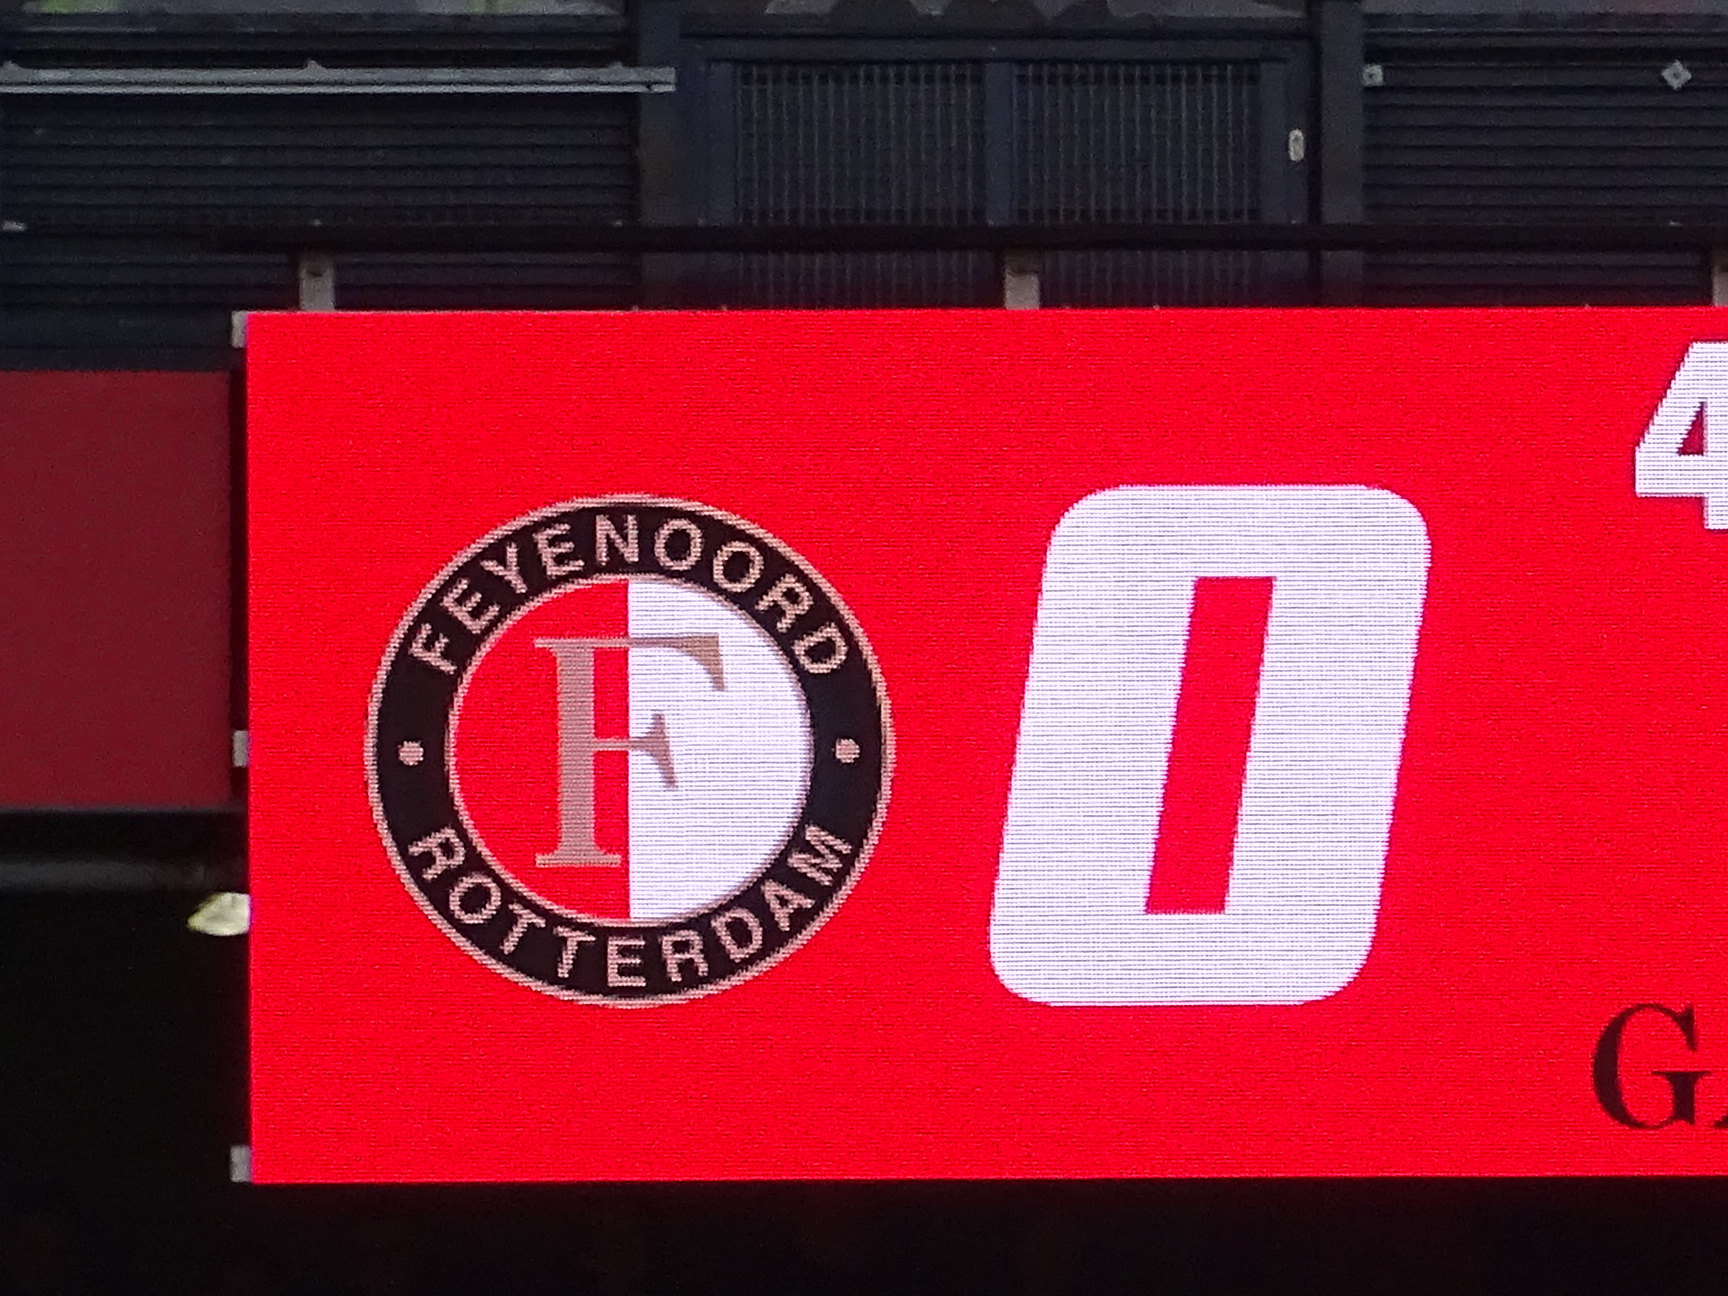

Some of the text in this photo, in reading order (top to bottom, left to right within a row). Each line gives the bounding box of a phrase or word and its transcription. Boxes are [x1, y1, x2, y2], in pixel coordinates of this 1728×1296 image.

[410, 514, 849, 676] FEYENOORD
[534, 632, 725, 868] F
[989, 484, 1432, 1007] 0
[407, 823, 853, 987] ROTTERDAM
